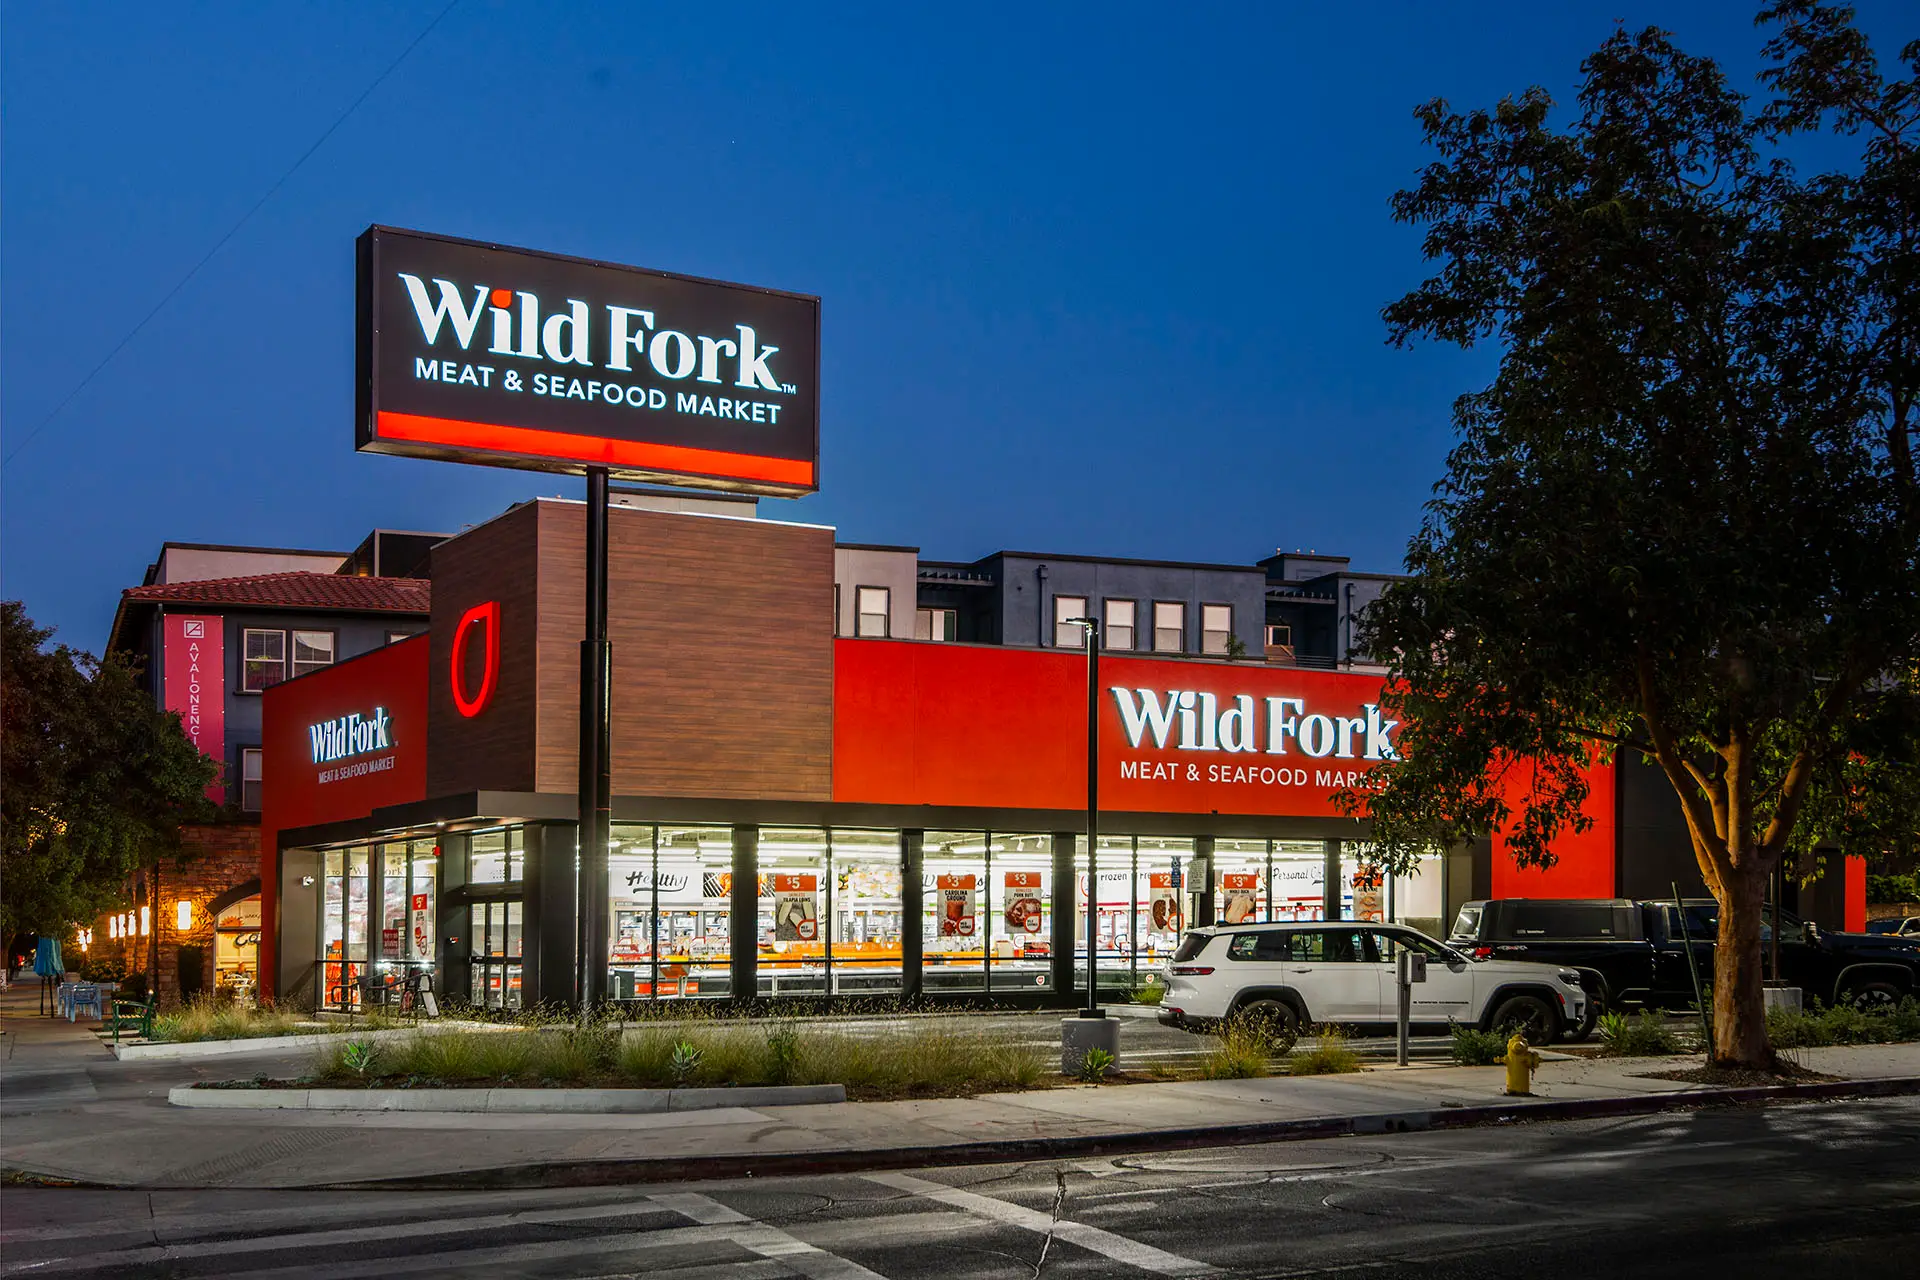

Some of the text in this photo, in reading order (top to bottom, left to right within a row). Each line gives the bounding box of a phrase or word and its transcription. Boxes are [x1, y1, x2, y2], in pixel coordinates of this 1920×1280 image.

[398, 272, 592, 367] Wild
[605, 304, 782, 393] Fork
[415, 357, 782, 424] MEAT & SEAFOOD MARKET
[189, 642, 201, 763] AVALONENCI
[1111, 686, 1401, 760] Wild Fork
[309, 706, 389, 764] Wild Fork
[318, 768, 335, 784] MEAT
[340, 762, 368, 780] SEAFOOD
[369, 756, 395, 773] MARKET
[1120, 760, 1179, 780] MEAT
[1187, 763, 1200, 781] &
[1208, 764, 1308, 786] SEAFOOD
[625, 871, 688, 894] Helthy
[1273, 868, 1309, 880] Personal
